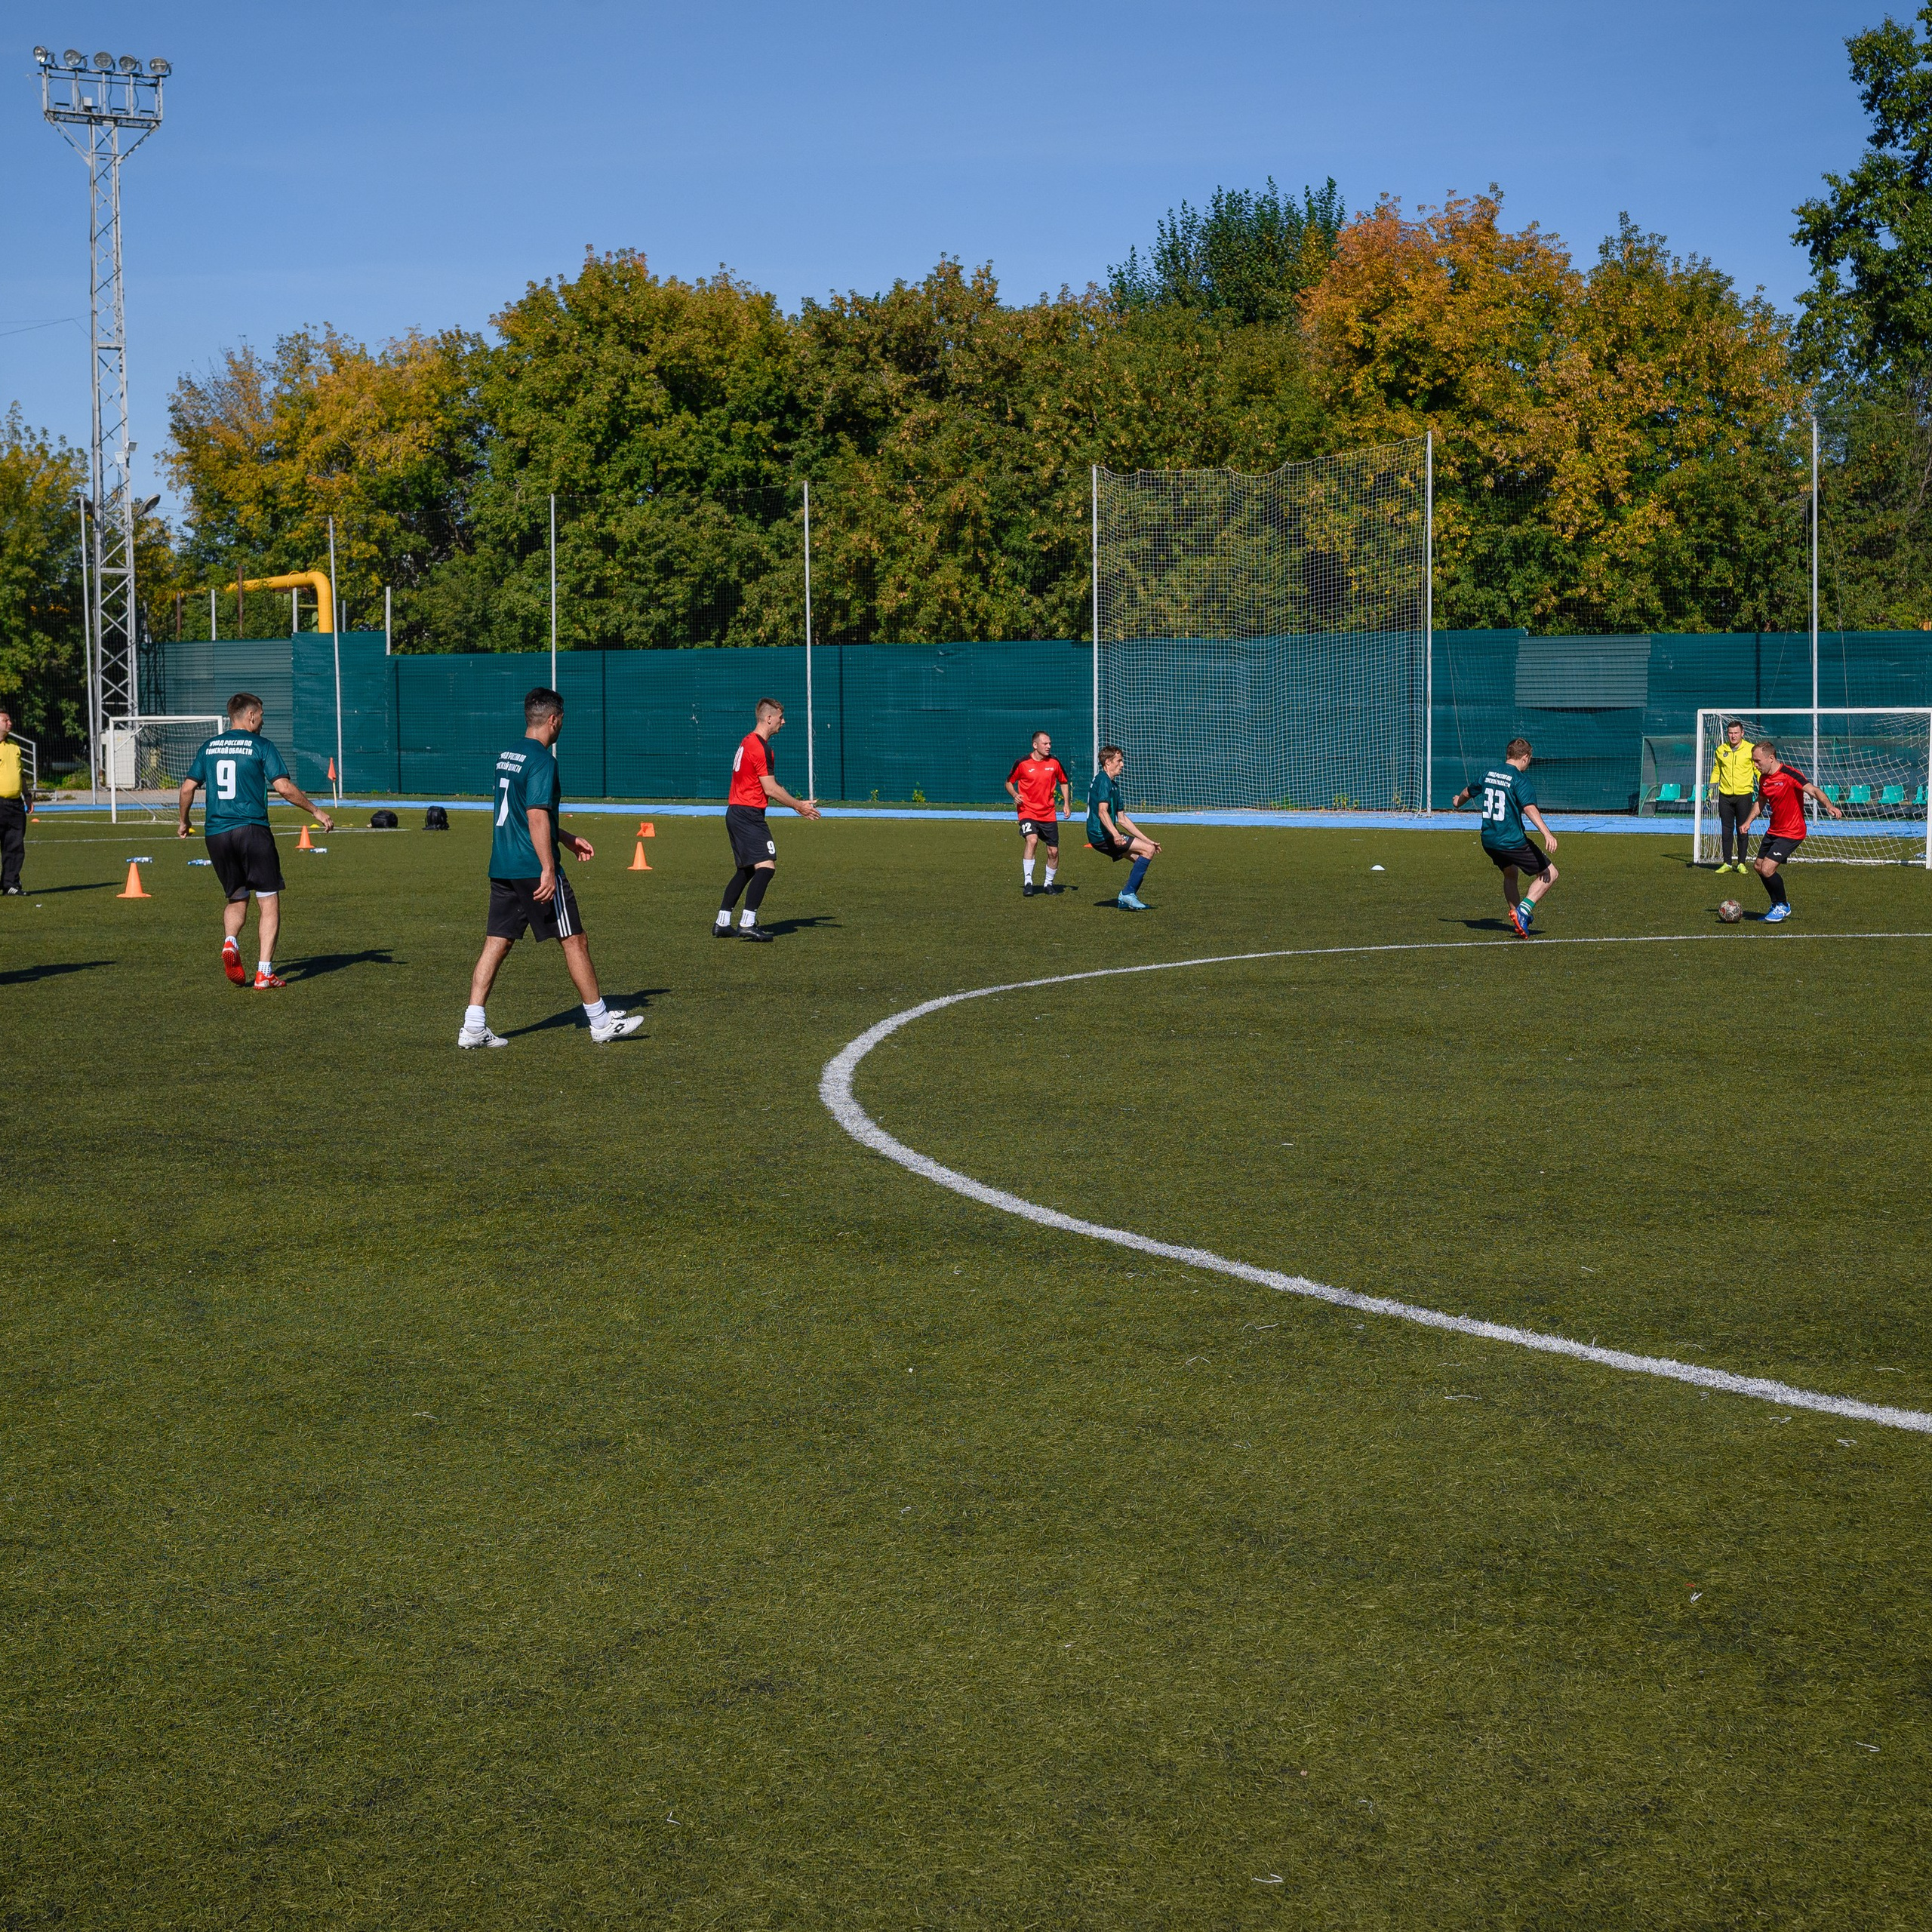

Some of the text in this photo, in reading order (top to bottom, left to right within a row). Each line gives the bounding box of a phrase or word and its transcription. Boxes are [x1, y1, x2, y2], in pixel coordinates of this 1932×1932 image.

[229, 747, 253, 755] ОБЛАСТИ
[217, 760, 235, 799] 9
[496, 777, 509, 826] 7
[1482, 787, 1506, 821] 33
[767, 840, 776, 854] 9
